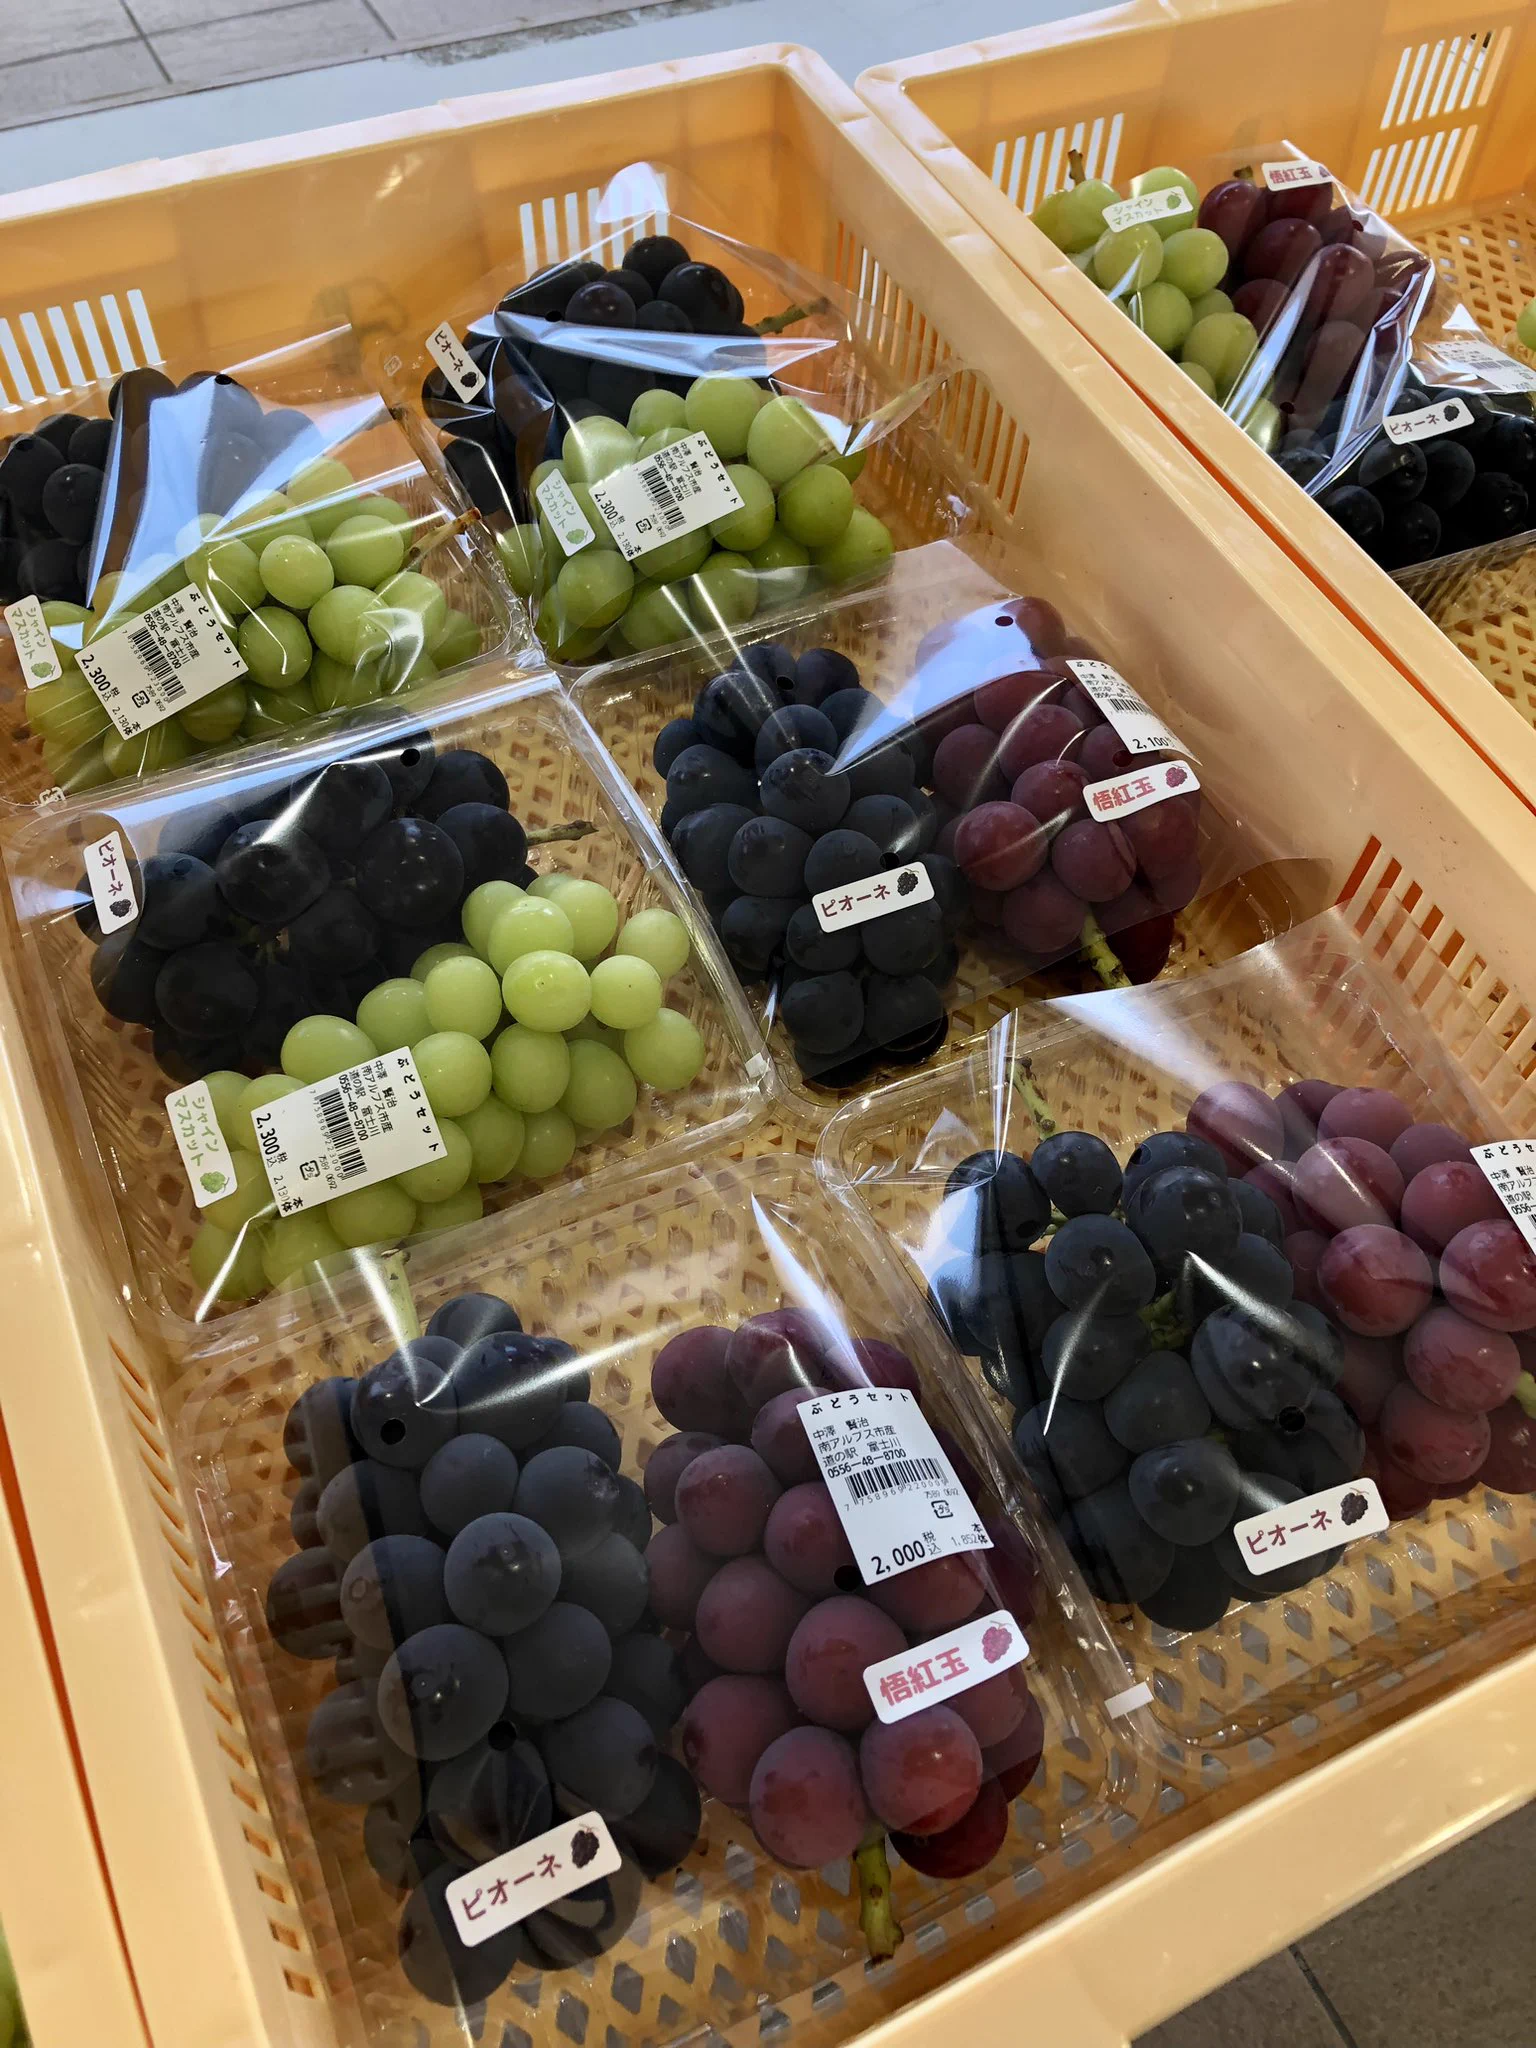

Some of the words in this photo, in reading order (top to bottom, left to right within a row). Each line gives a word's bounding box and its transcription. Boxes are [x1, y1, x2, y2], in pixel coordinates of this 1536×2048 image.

[435, 330, 463, 372] ピオーネ
[1390, 414, 1440, 435] ピオーネ
[696, 438, 738, 504] ぶどうセット
[541, 486, 566, 529] マスカット
[552, 480, 577, 516] シャイン
[594, 490, 618, 520] 2,300
[11, 607, 34, 660] マスカット
[26, 607, 47, 648] シャイン
[188, 591, 242, 668] ぶどうセット
[80, 654, 110, 692] 2,300
[1133, 737, 1168, 749] 2,100
[1093, 776, 1155, 811] 悟紅玉
[99, 840, 123, 896] ピオーネ
[821, 884, 890, 917] ピオーネ
[192, 1097, 220, 1152] シャイン
[397, 1056, 439, 1152] ぶどうセット
[175, 1096, 203, 1167] マスカット
[256, 1113, 280, 1155] 2,300
[810, 1391, 909, 1415] ぶどうセット
[1247, 1509, 1332, 1554] ピオーネ
[871, 1541, 926, 1575] 2,000
[879, 1648, 969, 1707] 悟紅玉
[462, 1854, 562, 1921] ピオーネ
